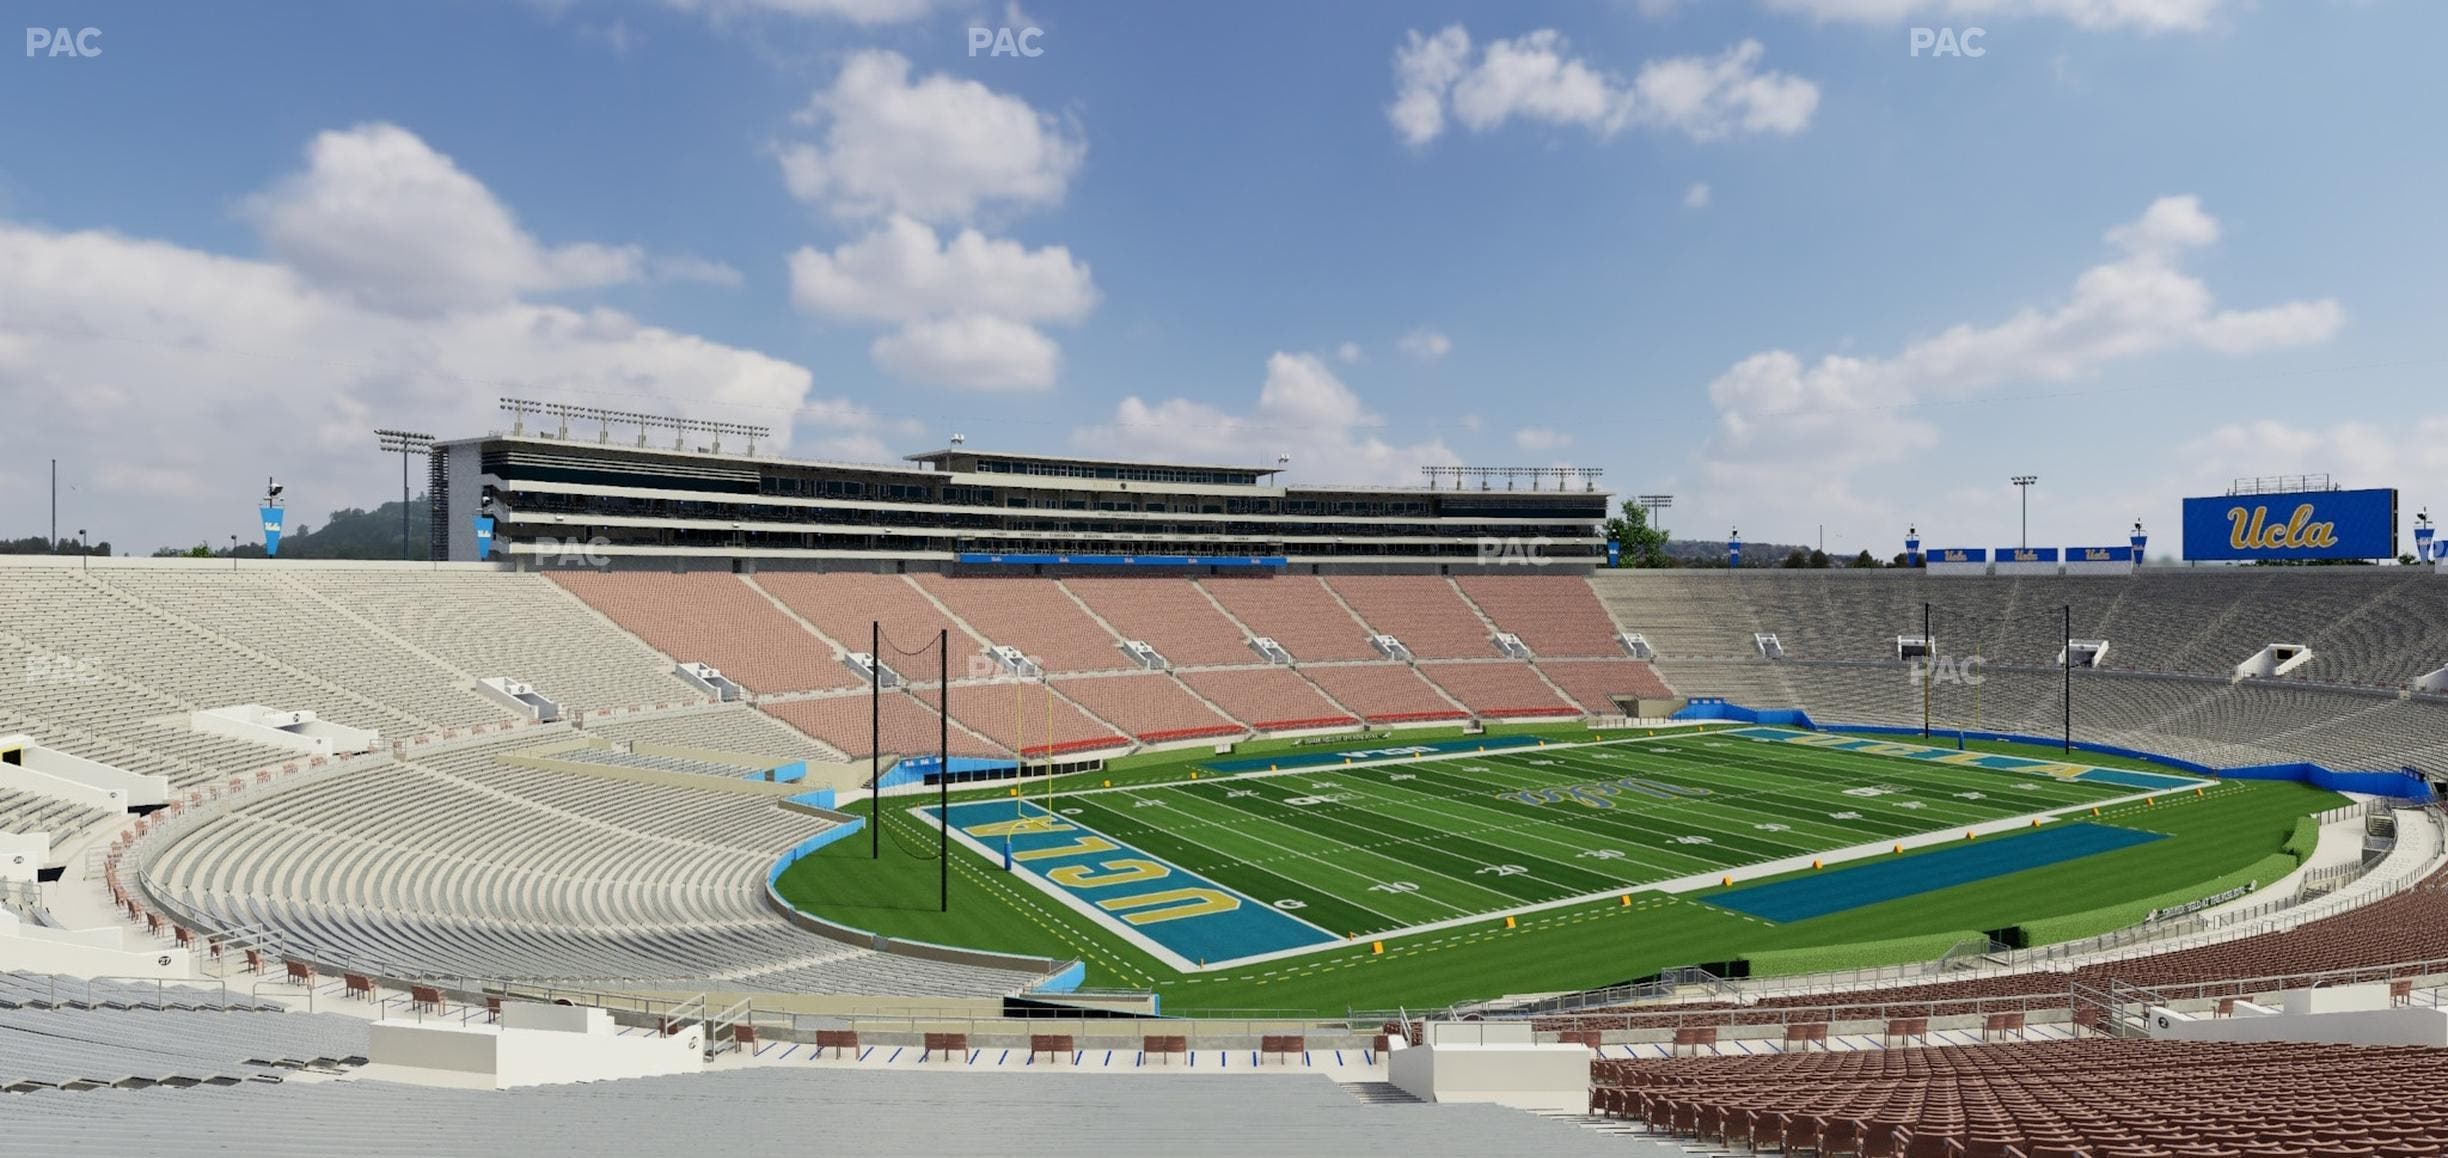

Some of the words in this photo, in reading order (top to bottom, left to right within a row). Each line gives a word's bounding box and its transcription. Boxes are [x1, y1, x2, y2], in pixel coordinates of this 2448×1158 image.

[2227, 503, 2338, 550] Ucla
[961, 815, 1243, 926] UCLA
[1484, 864, 1529, 877] 20
[1273, 899, 1308, 910] G
